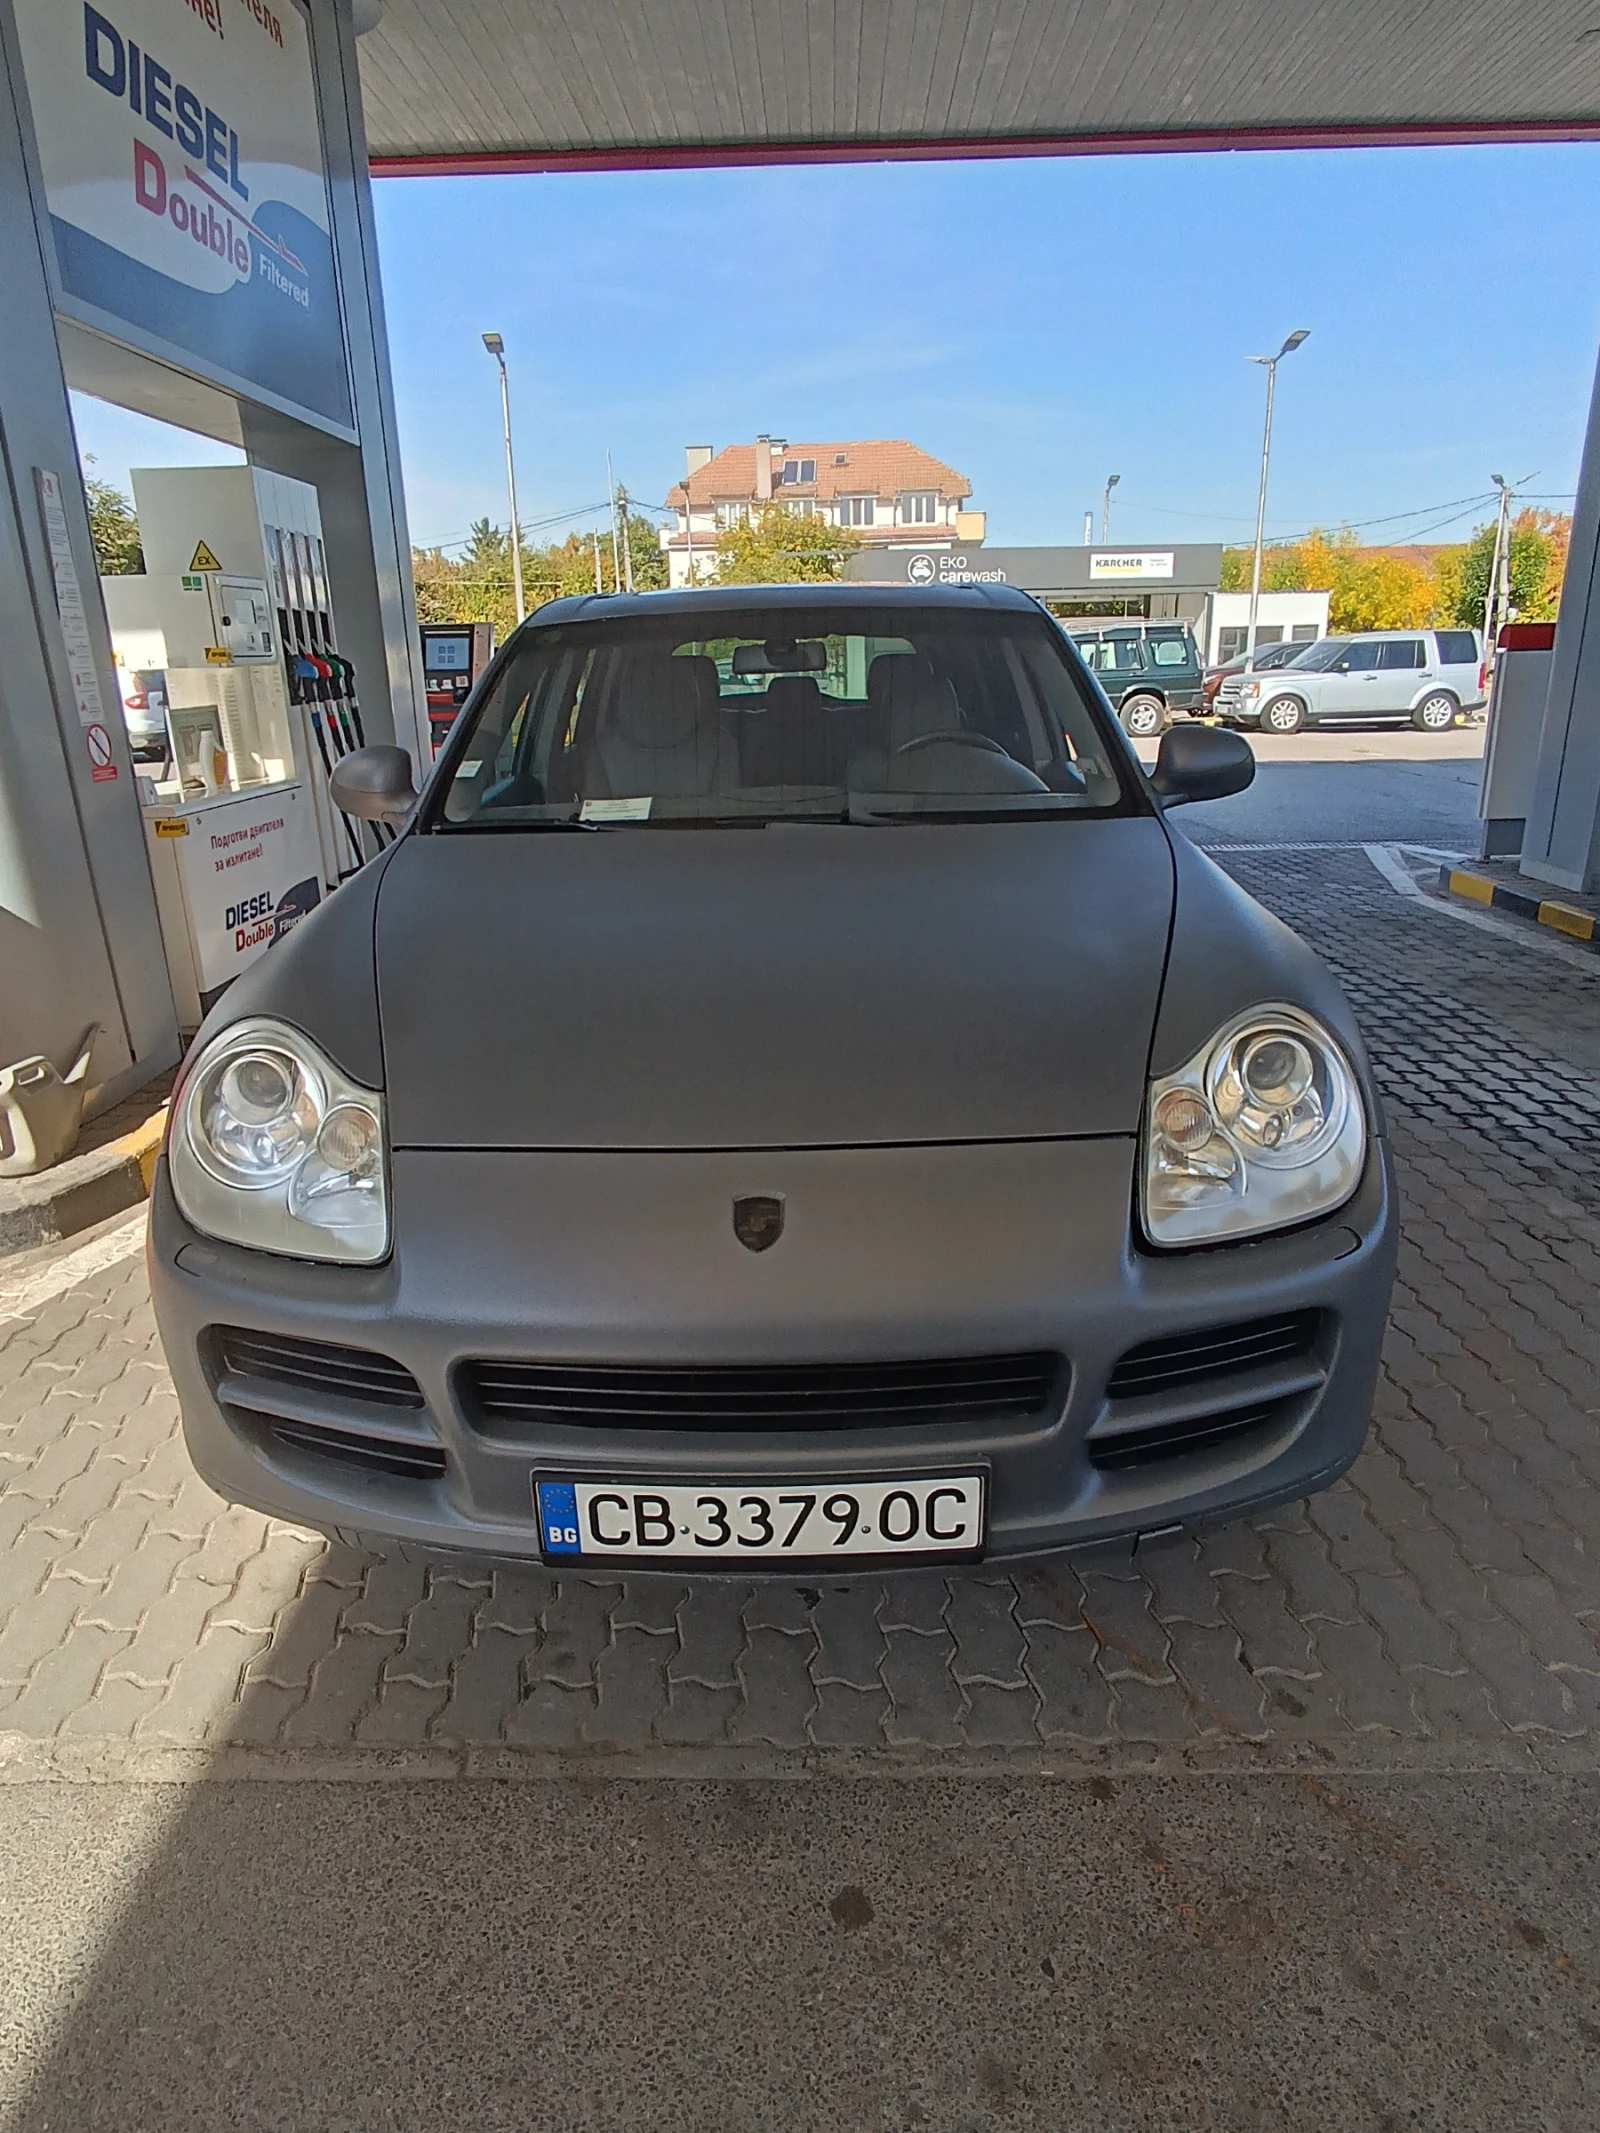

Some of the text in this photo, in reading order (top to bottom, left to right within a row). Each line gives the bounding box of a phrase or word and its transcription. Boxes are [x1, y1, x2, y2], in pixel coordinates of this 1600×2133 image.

[84, 1, 249, 202] DIESEL
[134, 138, 249, 274] Double
[259, 254, 310, 308] Filtered
[197, 556, 211, 565] EX
[939, 556, 968, 569] EKO
[939, 568, 1006, 583] carewash
[210, 818, 285, 849] Подготви двигателя
[214, 843, 264, 872] за излитане!
[225, 891, 275, 931] DIESEL
[235, 923, 274, 953] Double
[588, 1488, 968, 1548] CB 3379 OC
[549, 1526, 577, 1544] BG
